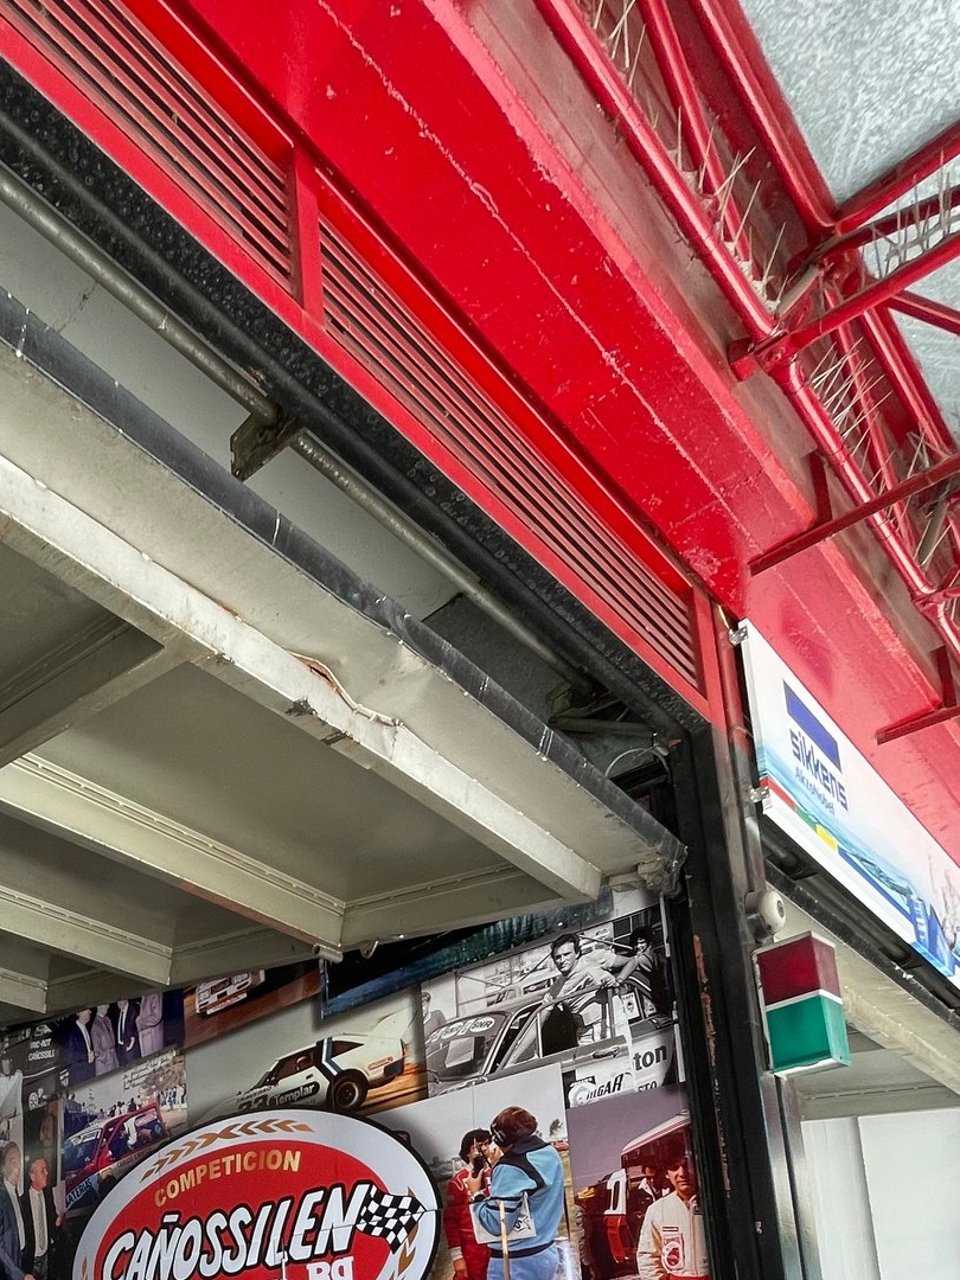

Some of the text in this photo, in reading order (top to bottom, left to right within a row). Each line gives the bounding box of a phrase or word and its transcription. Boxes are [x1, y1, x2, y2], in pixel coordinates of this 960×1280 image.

[789, 727, 848, 812] sikkens
[275, 1083, 315, 1106] Templar
[154, 1149, 302, 1208] COMPETICION
